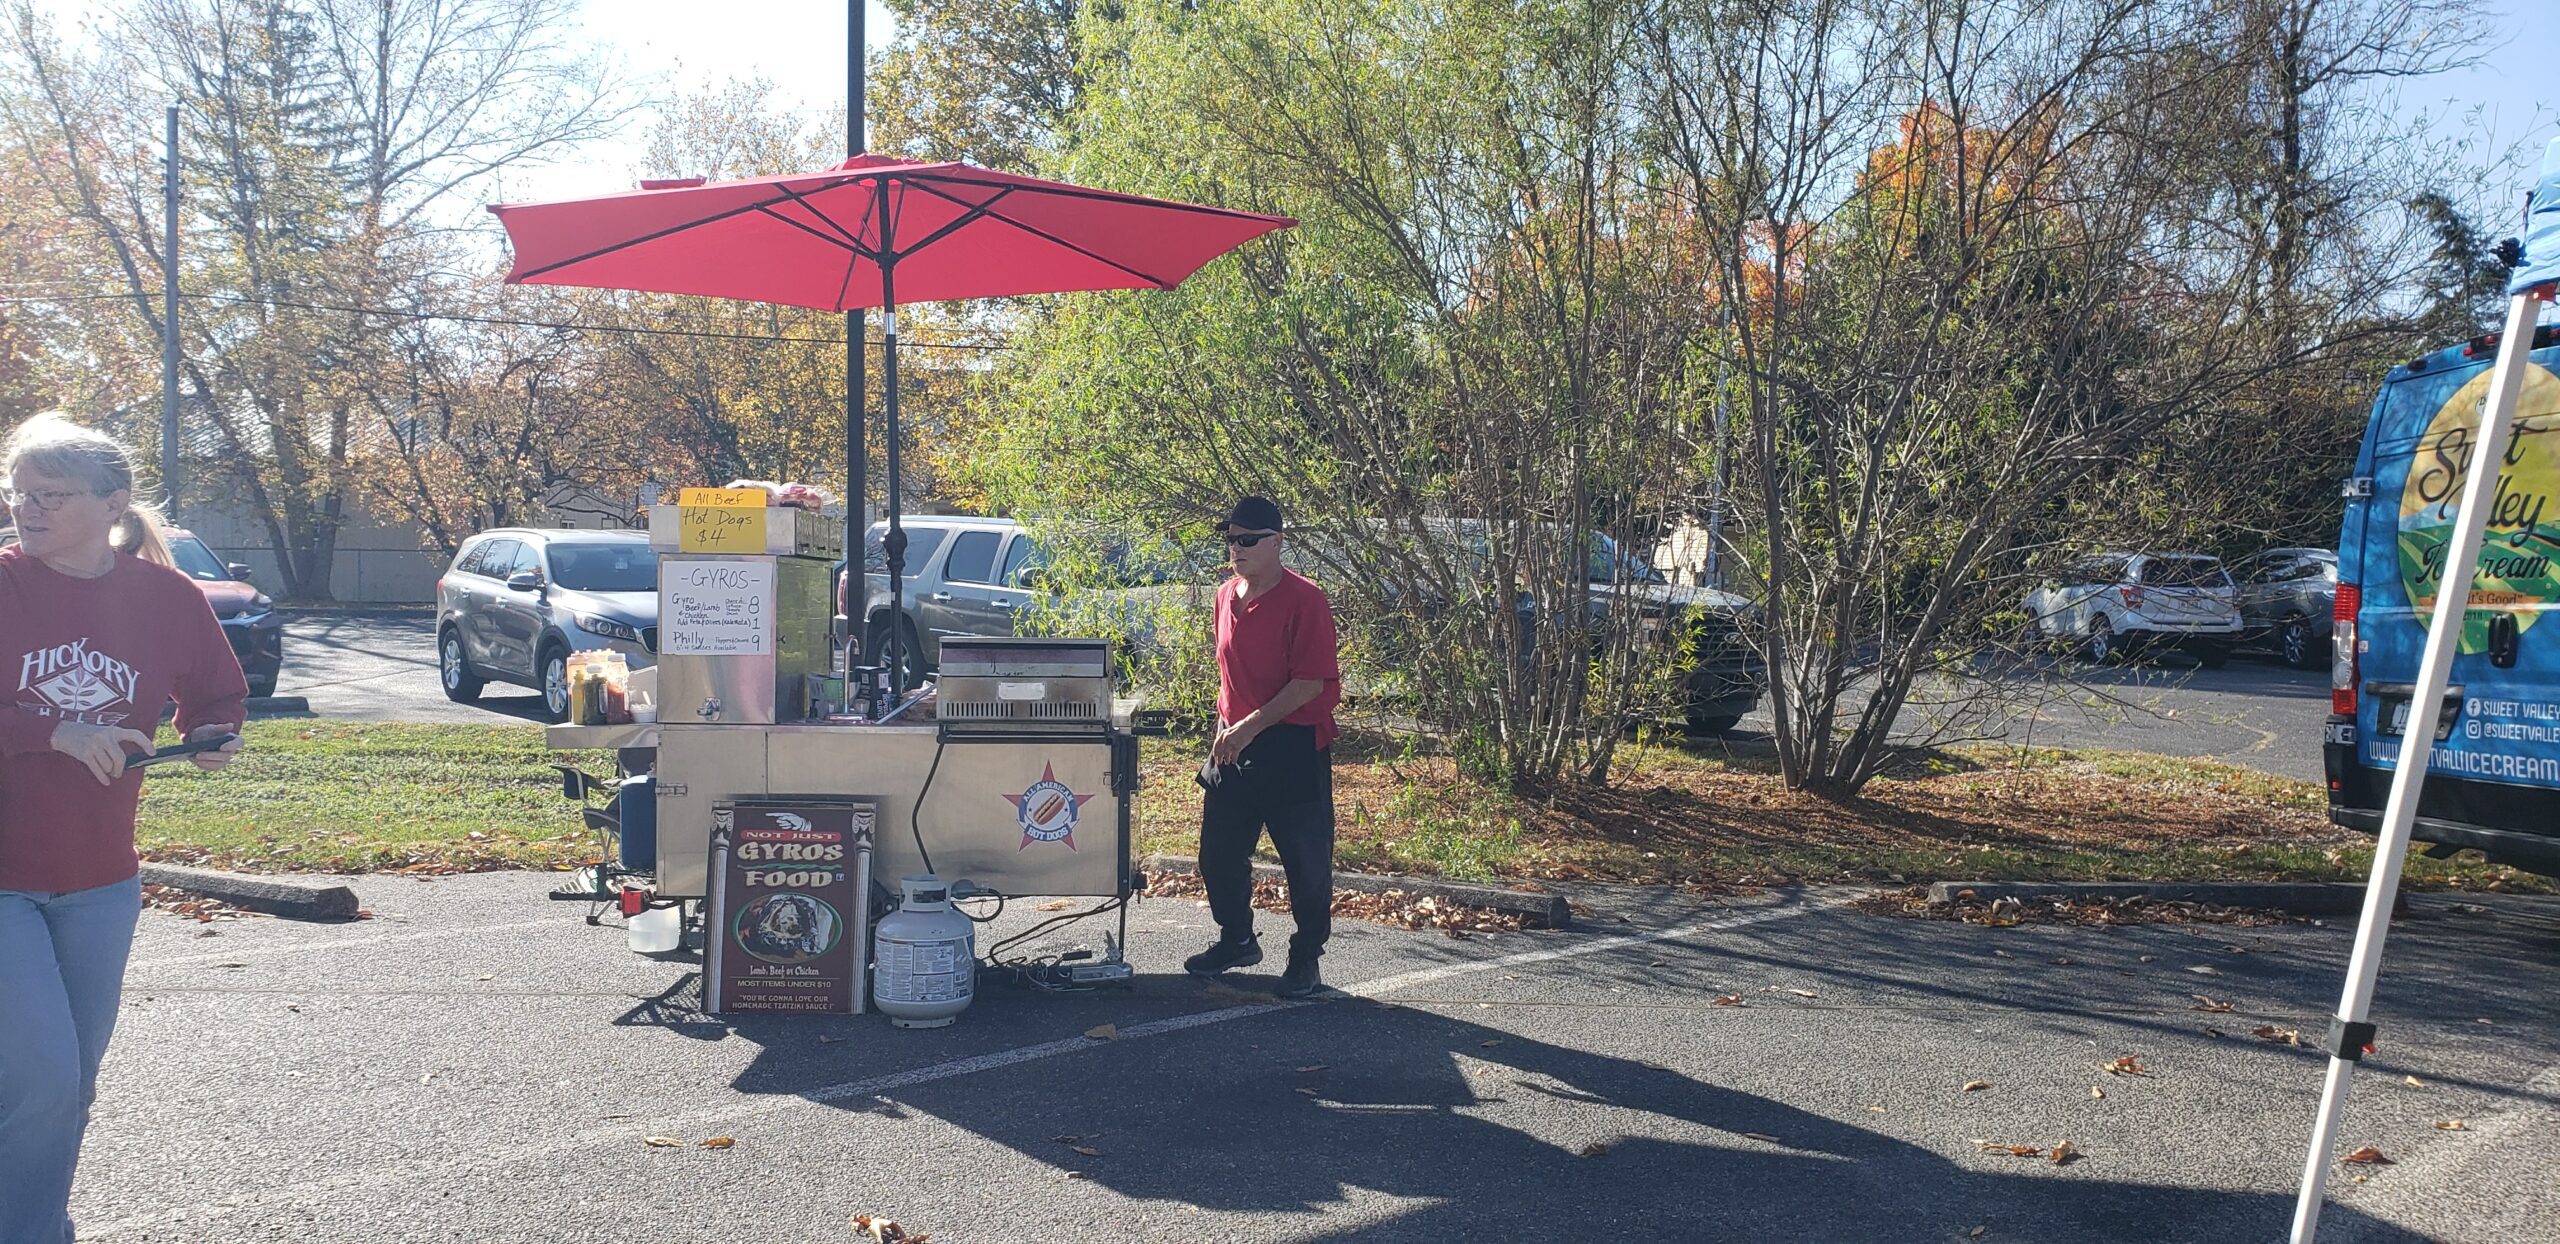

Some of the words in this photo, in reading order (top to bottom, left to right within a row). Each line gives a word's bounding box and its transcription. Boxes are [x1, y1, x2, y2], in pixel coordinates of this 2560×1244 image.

[694, 492, 708, 504] All
[714, 493, 744, 505] Beef
[683, 507, 708, 525] Hot
[716, 509, 752, 531] Dogs
[696, 528, 726, 546] $4
[2473, 538, 2552, 579] ream
[672, 593, 694, 608] Gyro
[748, 596, 760, 614] 8
[752, 618, 760, 629] 1
[673, 632, 704, 648] Philly
[751, 635, 760, 651] 9
[17, 638, 141, 704] HICKORY
[2483, 701, 2520, 717] SWEET
[2523, 702, 2560, 720] VALLEY
[1024, 787, 1037, 802] ALL
[1036, 781, 1074, 802] AMERICAN
[1027, 827, 1046, 840] HOT
[1046, 827, 1068, 840] DOGS
[737, 842, 844, 860] GYROS
[745, 871, 833, 888] FOOD
[769, 965, 786, 979] Beef
[786, 967, 794, 976] or
[795, 965, 819, 976] Chicken
[762, 980, 786, 988] ITEMS
[774, 1002, 804, 1010] TZATZIKI
